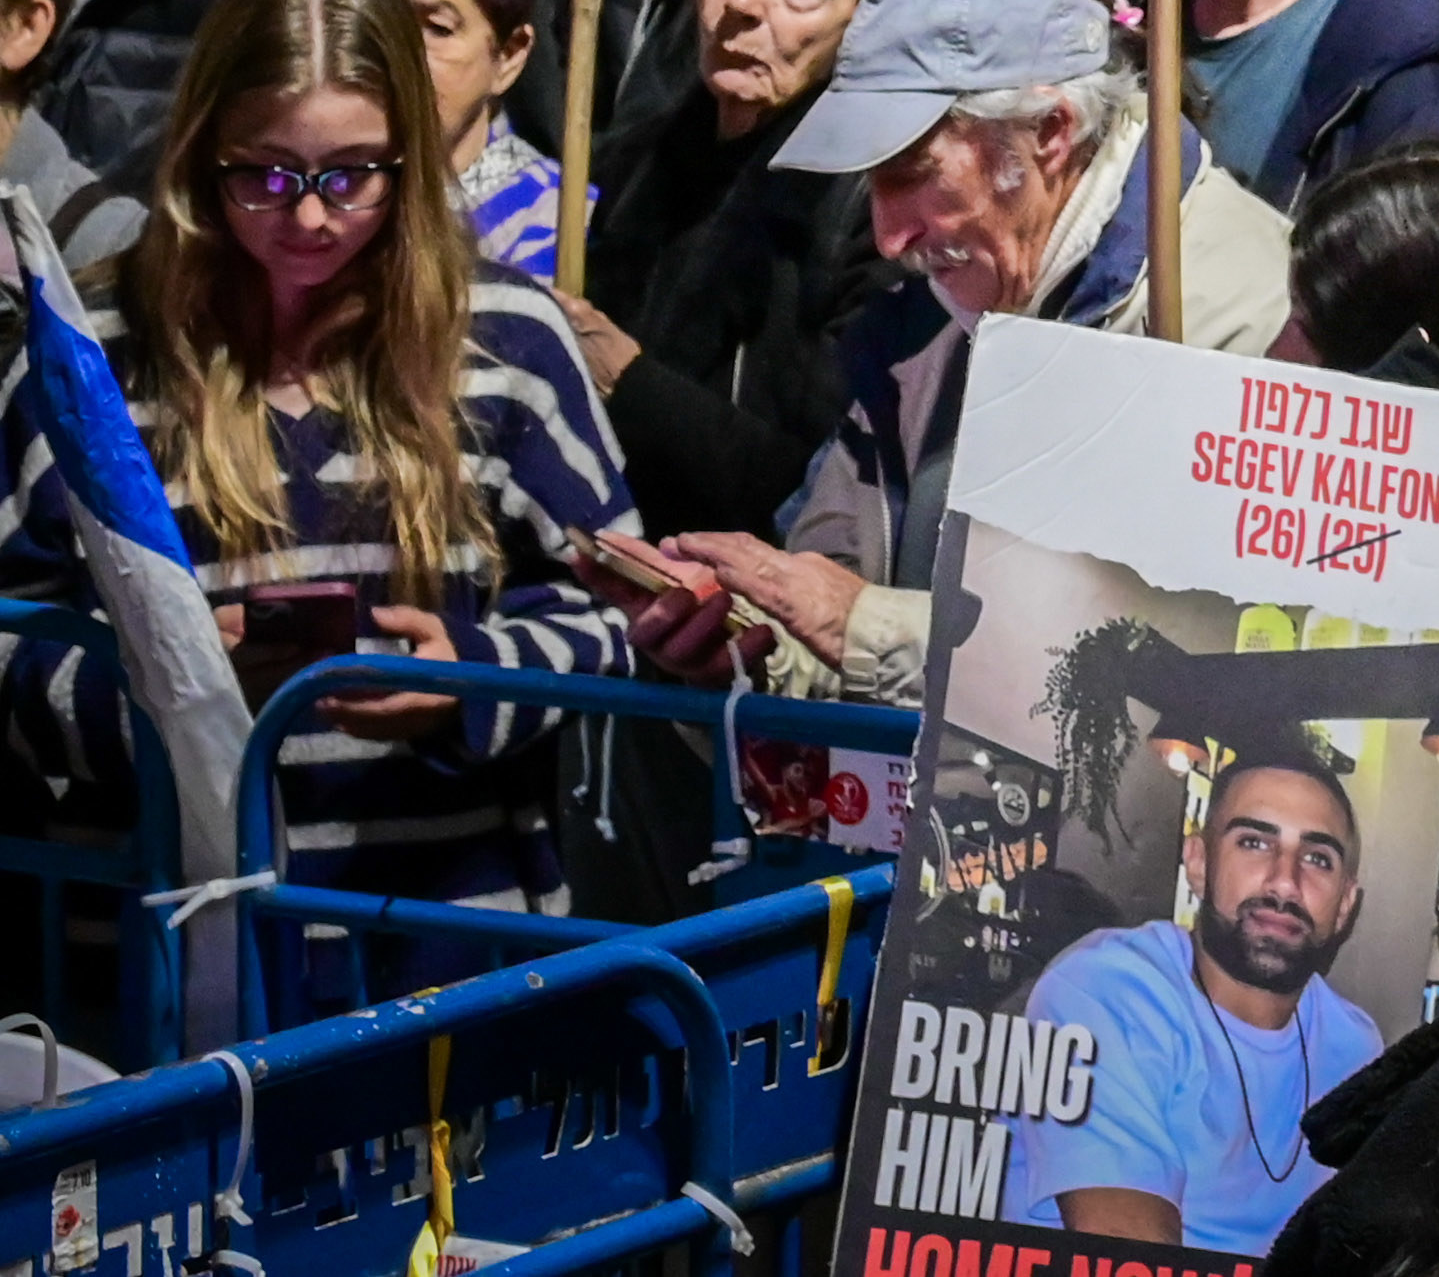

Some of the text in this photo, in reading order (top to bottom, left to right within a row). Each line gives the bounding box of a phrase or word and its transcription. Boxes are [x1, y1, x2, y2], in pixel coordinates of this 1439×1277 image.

[1192, 431, 1303, 494] SEGEV
[1238, 377, 1414, 455] שגב כלפון
[889, 999, 1096, 1123] BRING
[875, 1108, 1012, 1220] HIM
